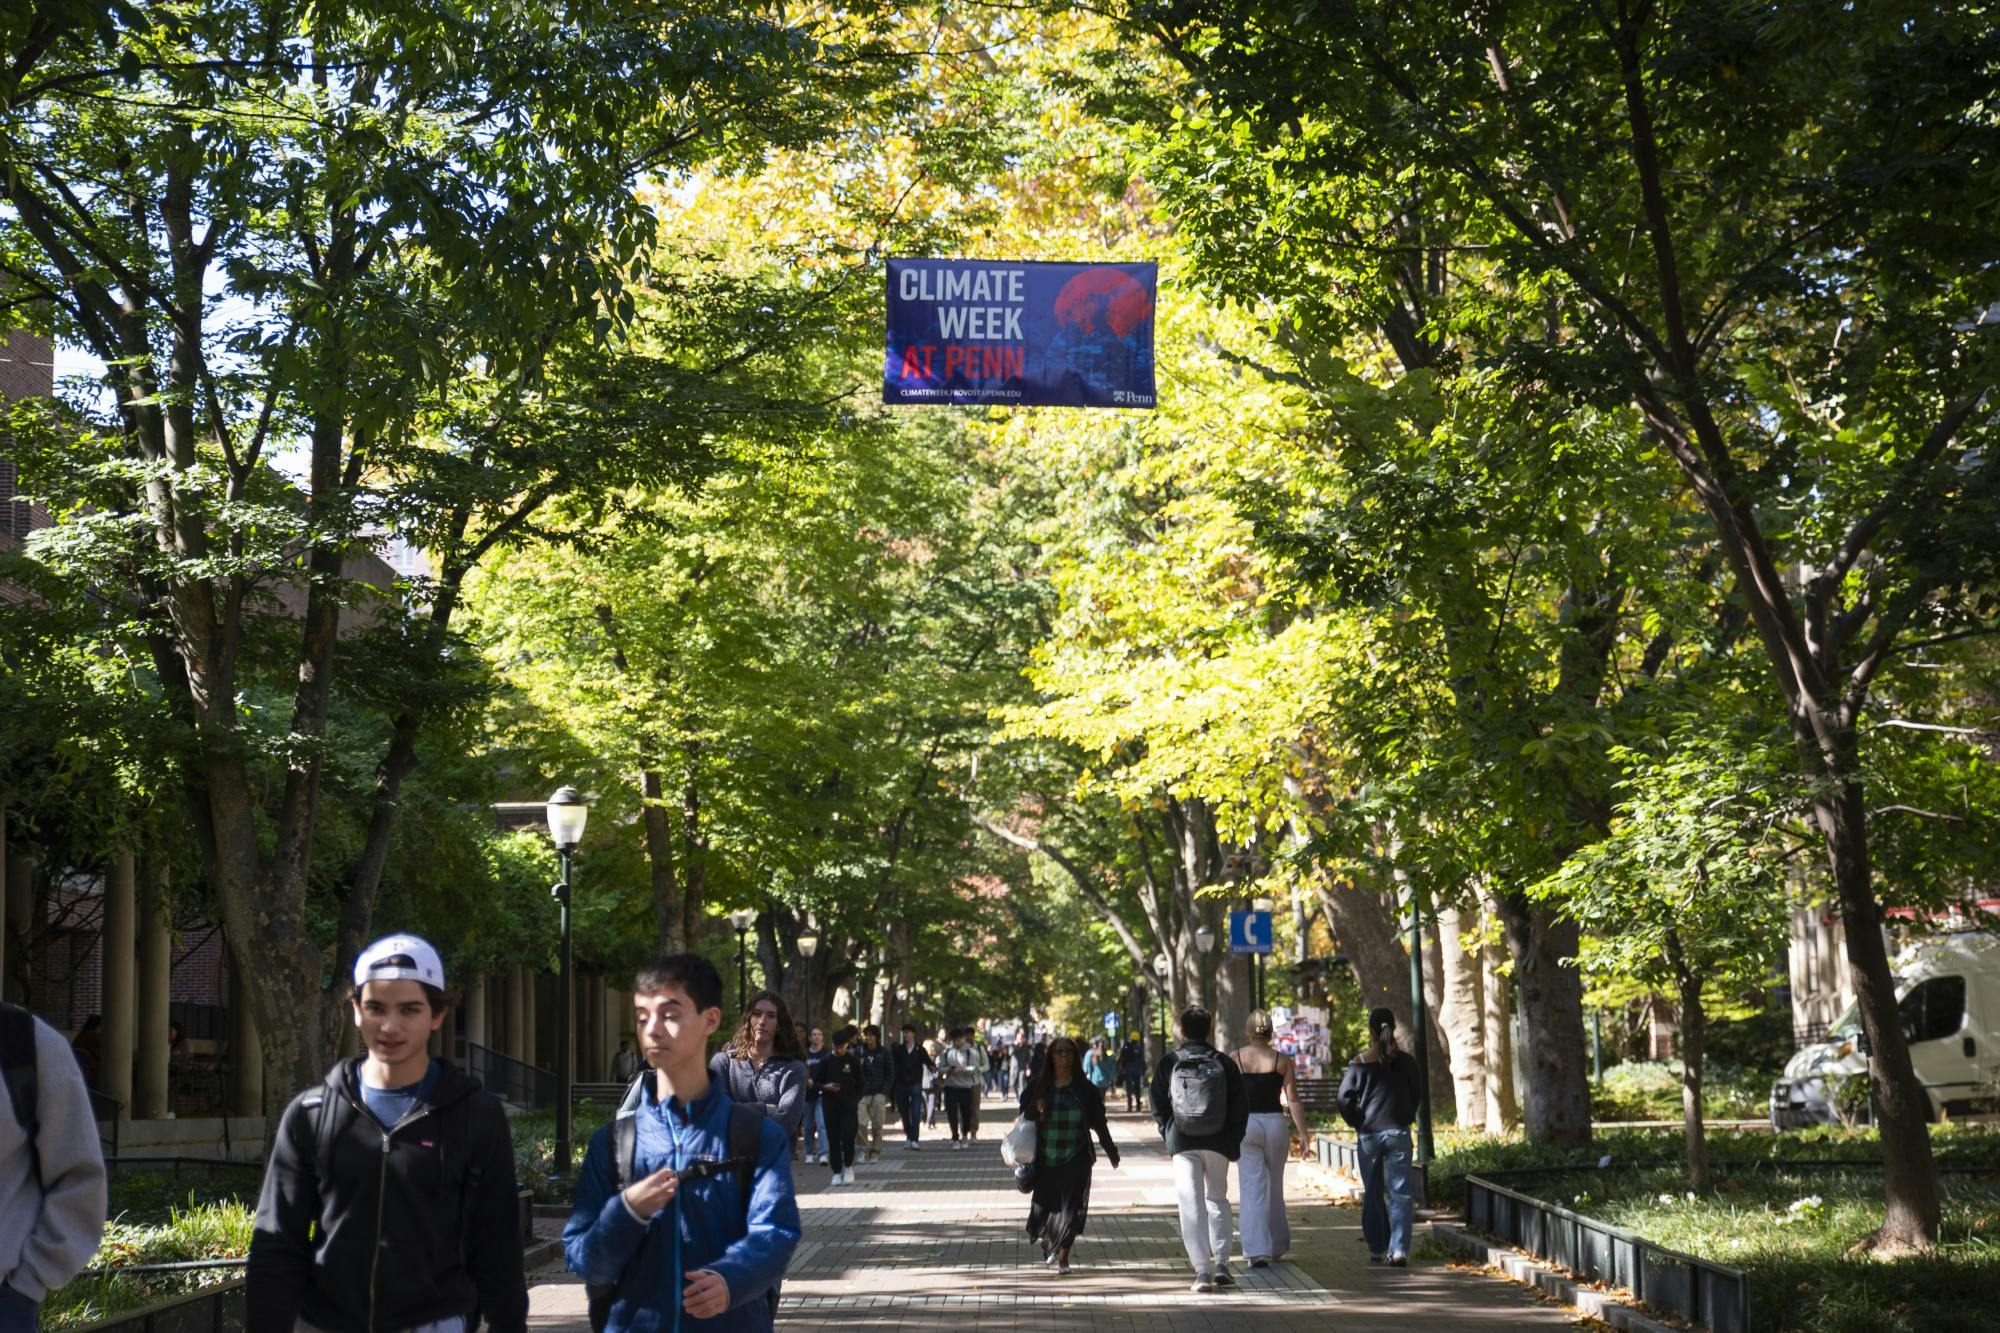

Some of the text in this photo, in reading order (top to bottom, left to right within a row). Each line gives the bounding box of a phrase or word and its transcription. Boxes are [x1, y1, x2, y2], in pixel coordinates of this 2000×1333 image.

[900, 268, 1025, 302] CLIMATE
[937, 306, 1024, 340] WEEK
[901, 345, 1024, 379] AT PENN
[1126, 391, 1153, 403] Penn
